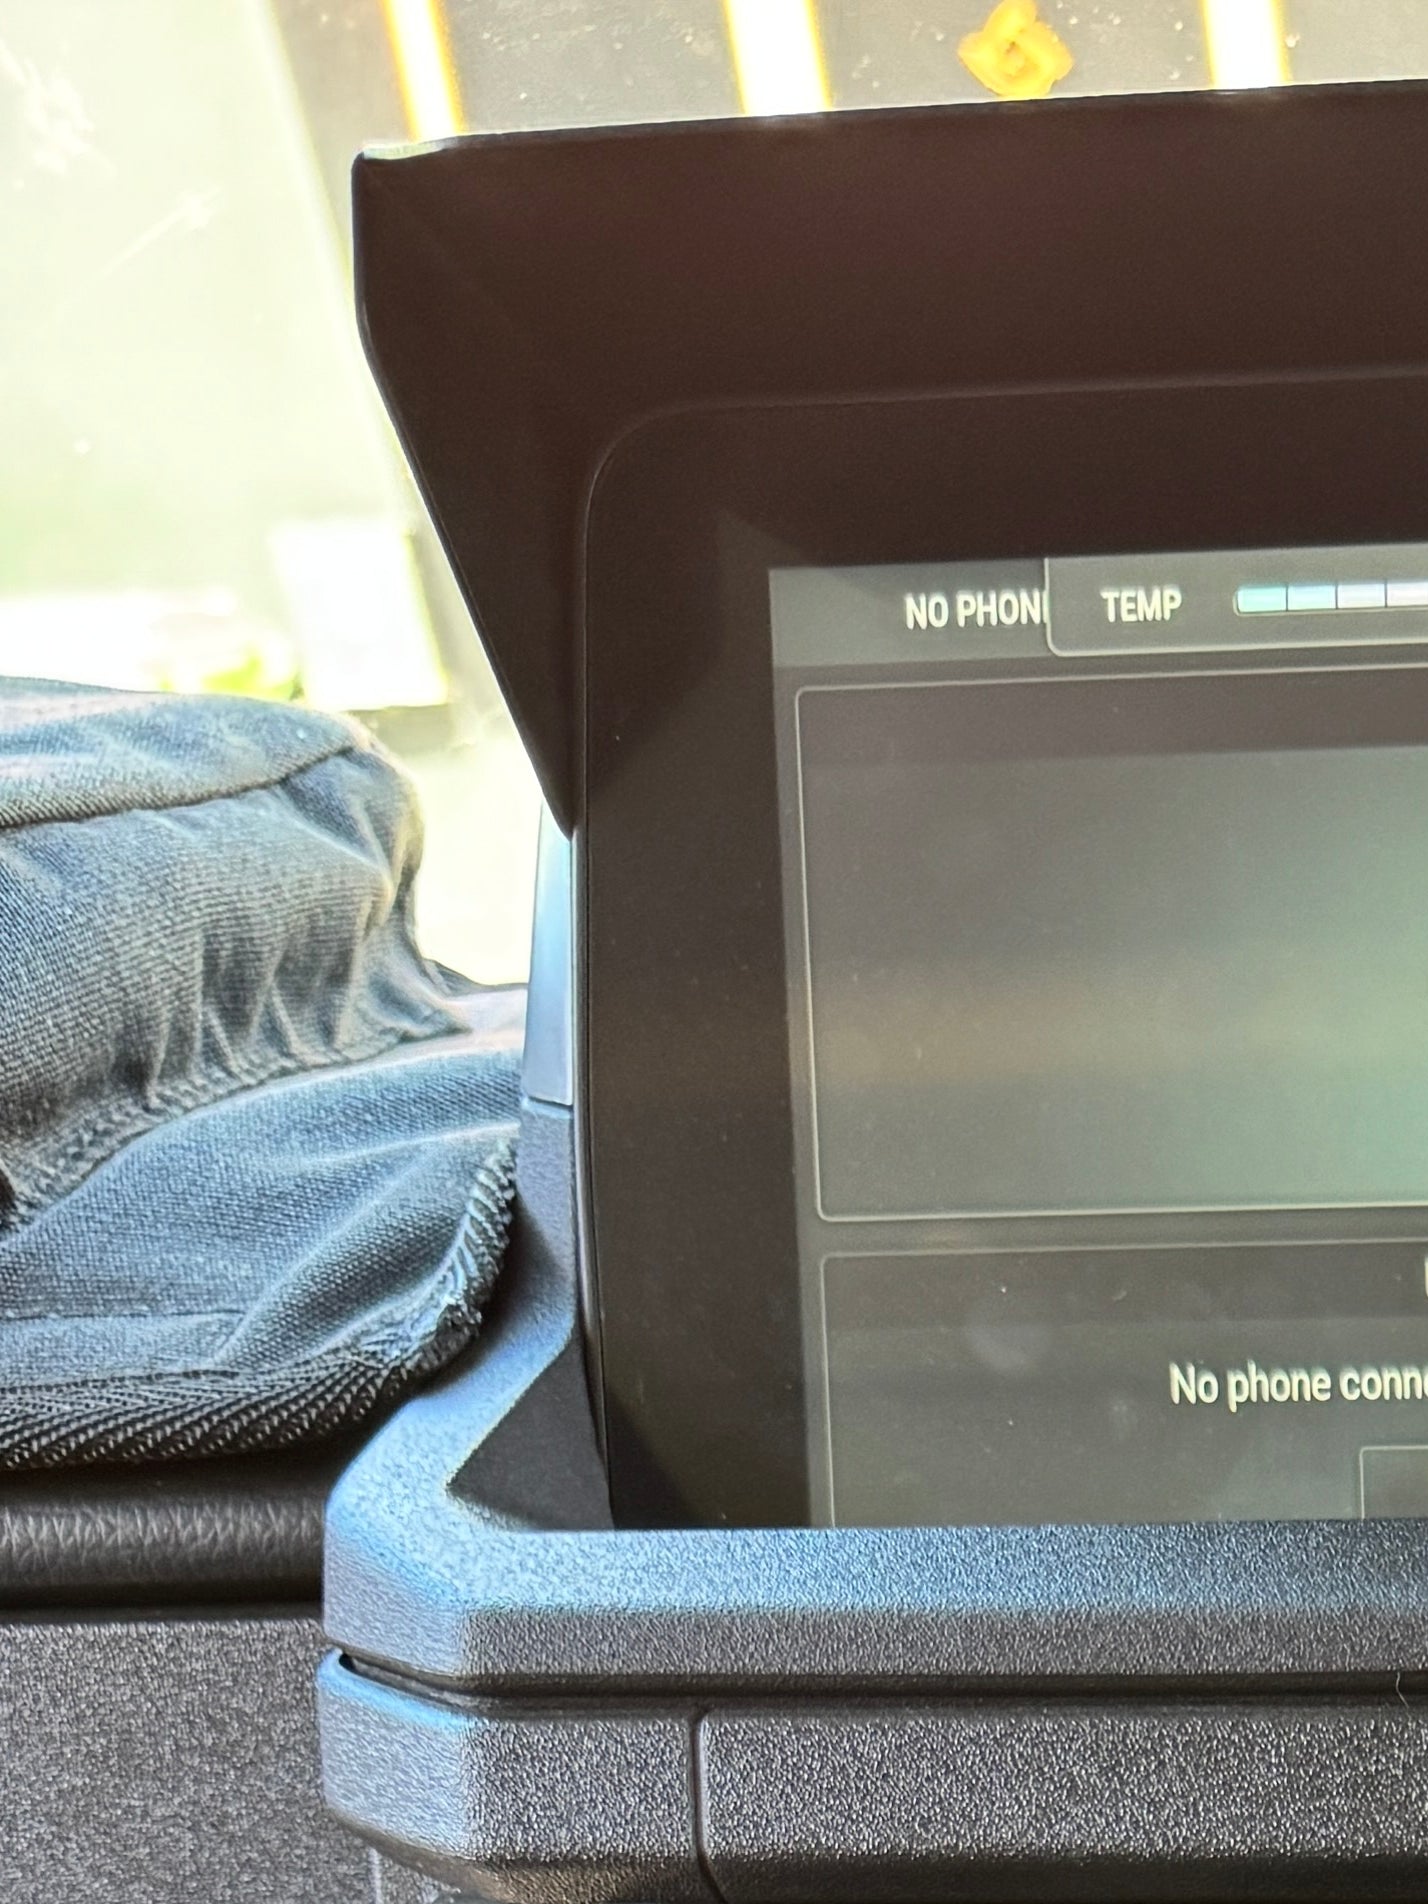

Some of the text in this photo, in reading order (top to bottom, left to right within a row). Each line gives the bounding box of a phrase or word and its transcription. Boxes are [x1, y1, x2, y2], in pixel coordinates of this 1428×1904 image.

[904, 586, 1048, 629] NO PHON
[1100, 585, 1182, 622] TEMP
[1170, 1363, 1218, 1404] No
[1227, 1360, 1331, 1412] phone
